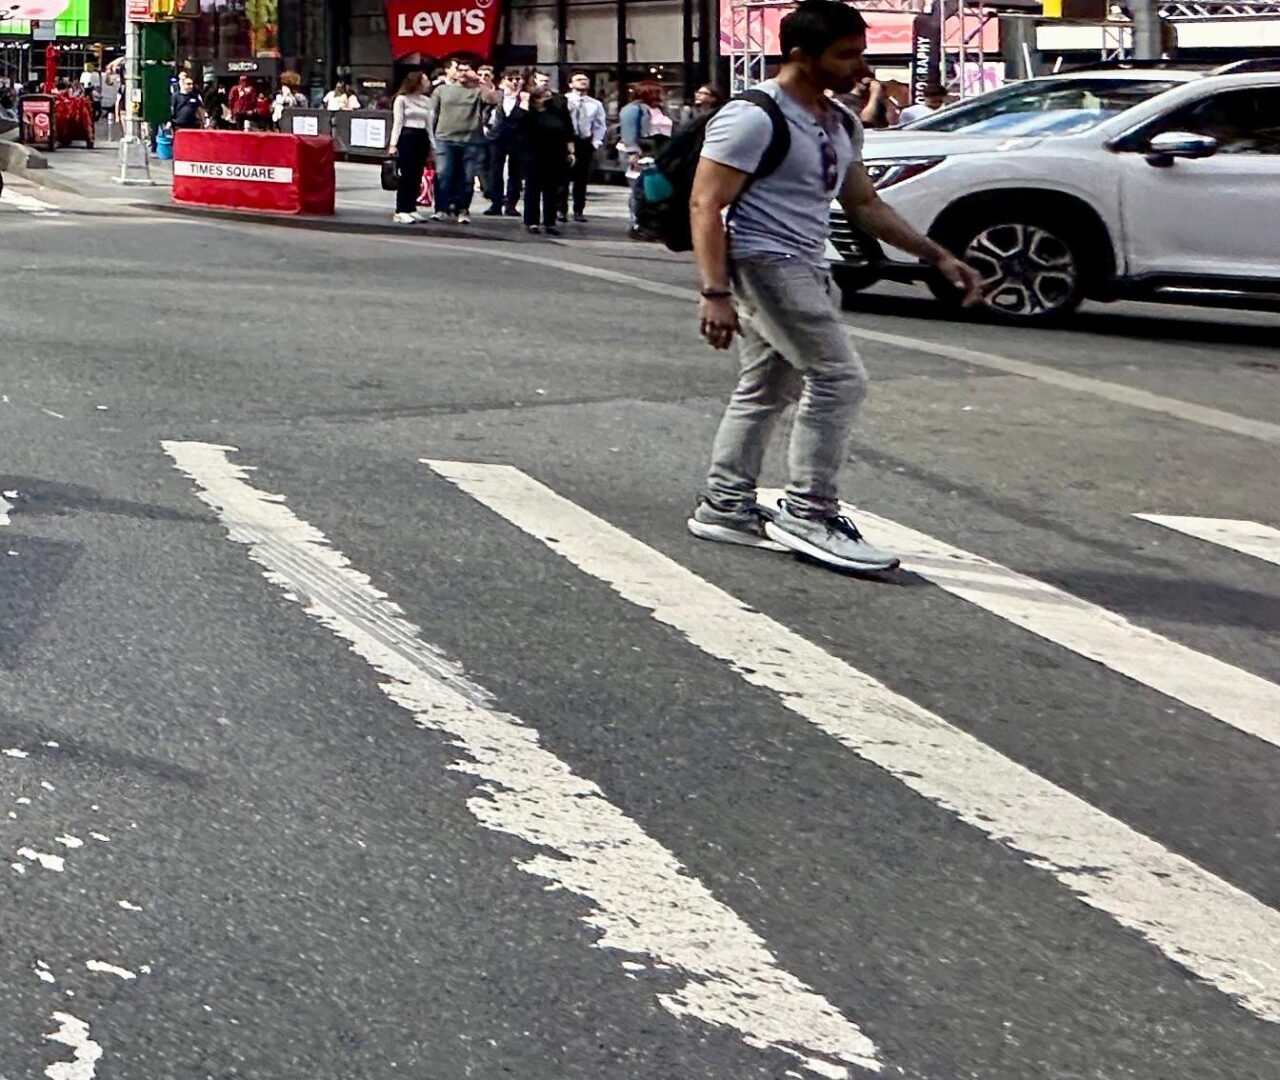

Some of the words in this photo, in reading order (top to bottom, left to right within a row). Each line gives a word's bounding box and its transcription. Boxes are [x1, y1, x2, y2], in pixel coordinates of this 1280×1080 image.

[397, 9, 485, 37] LeVI'S
[190, 163, 225, 178] TIMES
[229, 165, 276, 180] SQUARE
